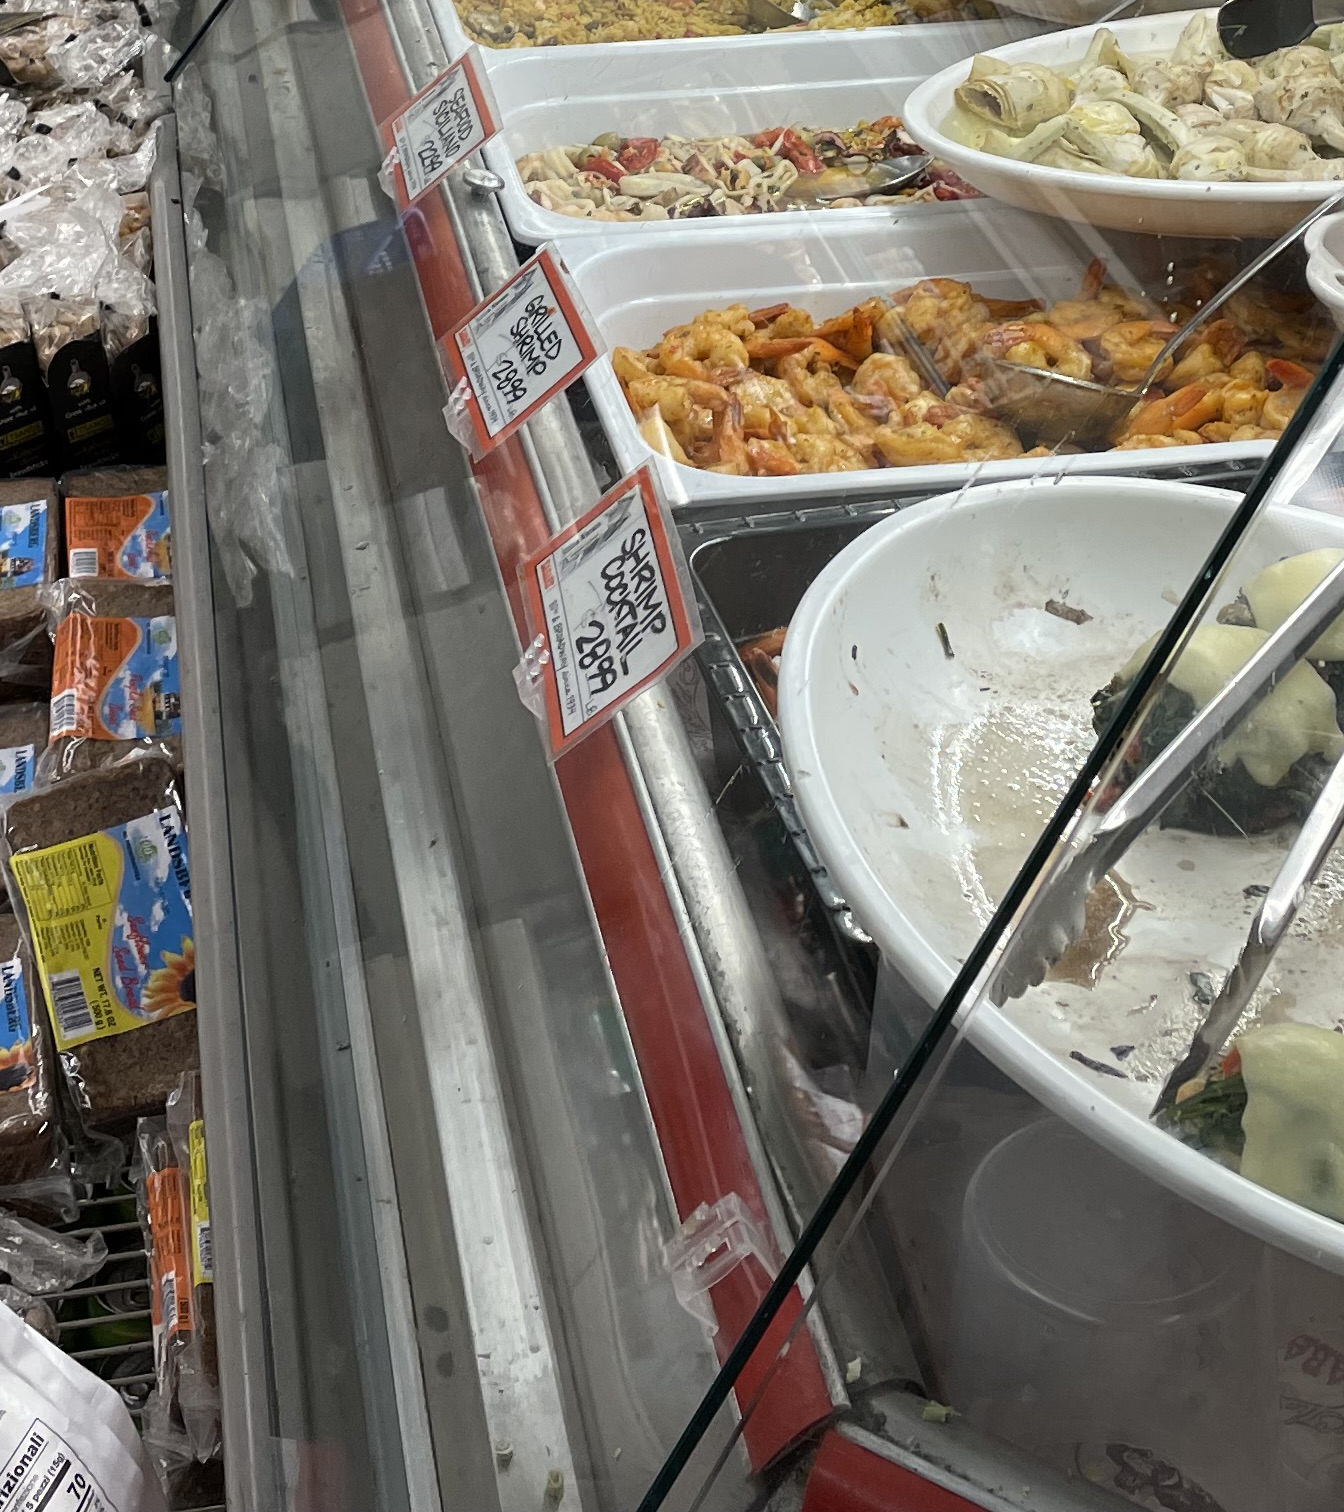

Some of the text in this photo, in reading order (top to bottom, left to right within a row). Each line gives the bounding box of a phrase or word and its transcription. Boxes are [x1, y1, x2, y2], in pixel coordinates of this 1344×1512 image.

[433, 100, 460, 158] SICILIANO
[510, 316, 546, 376] SHRIMP
[524, 294, 563, 361] GRILLED
[622, 528, 666, 635] SHRIMP
[601, 557, 643, 676] COCKTAIL
[91, 966, 103, 986] NET
[25, 1500, 35, 1511] 5
[66, 1473, 87, 1500] 70
